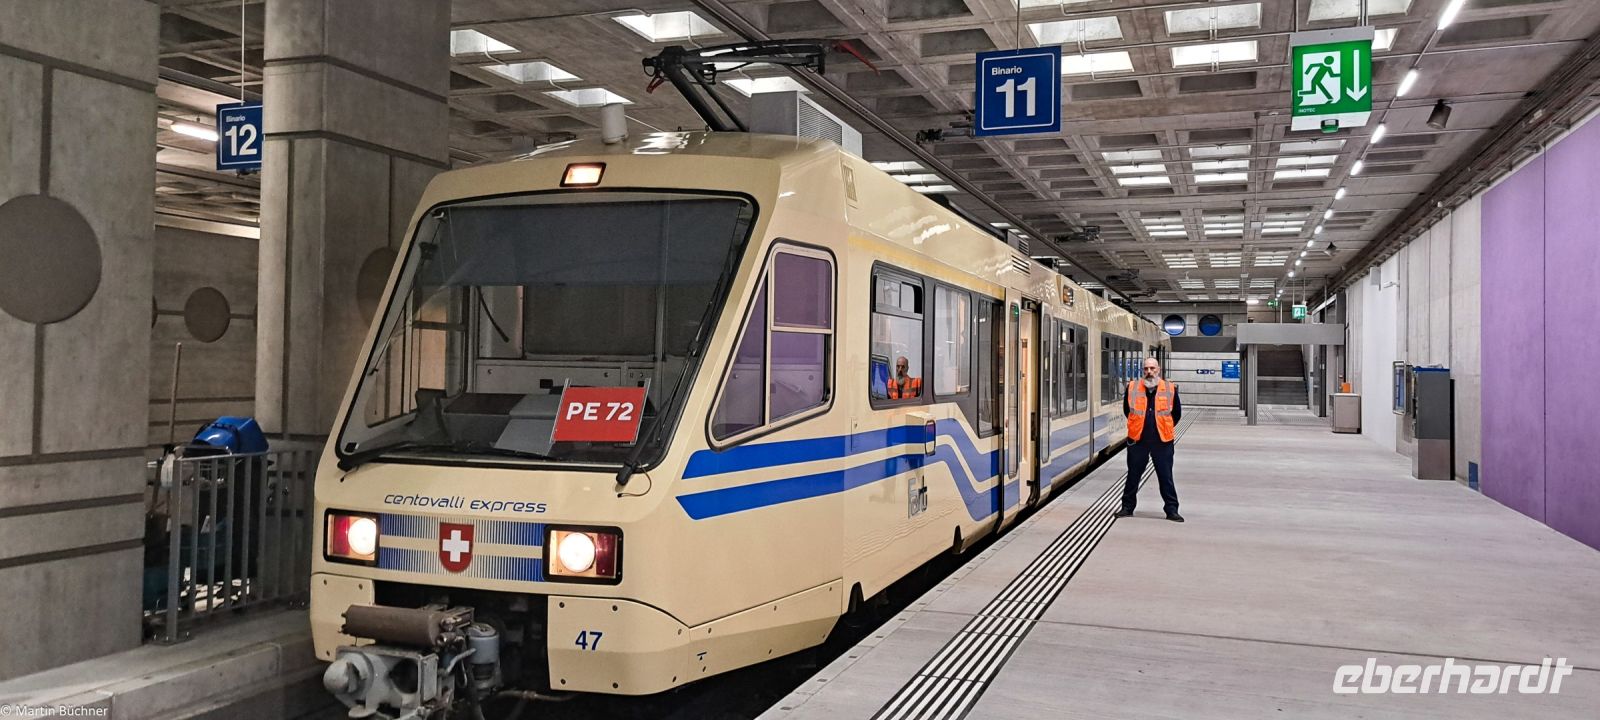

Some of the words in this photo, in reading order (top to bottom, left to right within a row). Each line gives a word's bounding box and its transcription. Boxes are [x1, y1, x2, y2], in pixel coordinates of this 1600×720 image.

[991, 66, 1023, 76] Binario
[995, 76, 1036, 118] 11
[225, 115, 246, 123] Binario
[225, 123, 258, 156] 12
[566, 402, 601, 421] PE
[605, 402, 634, 421] 72
[384, 494, 465, 509] centovalli
[469, 499, 547, 513] express
[575, 630, 603, 651] 47
